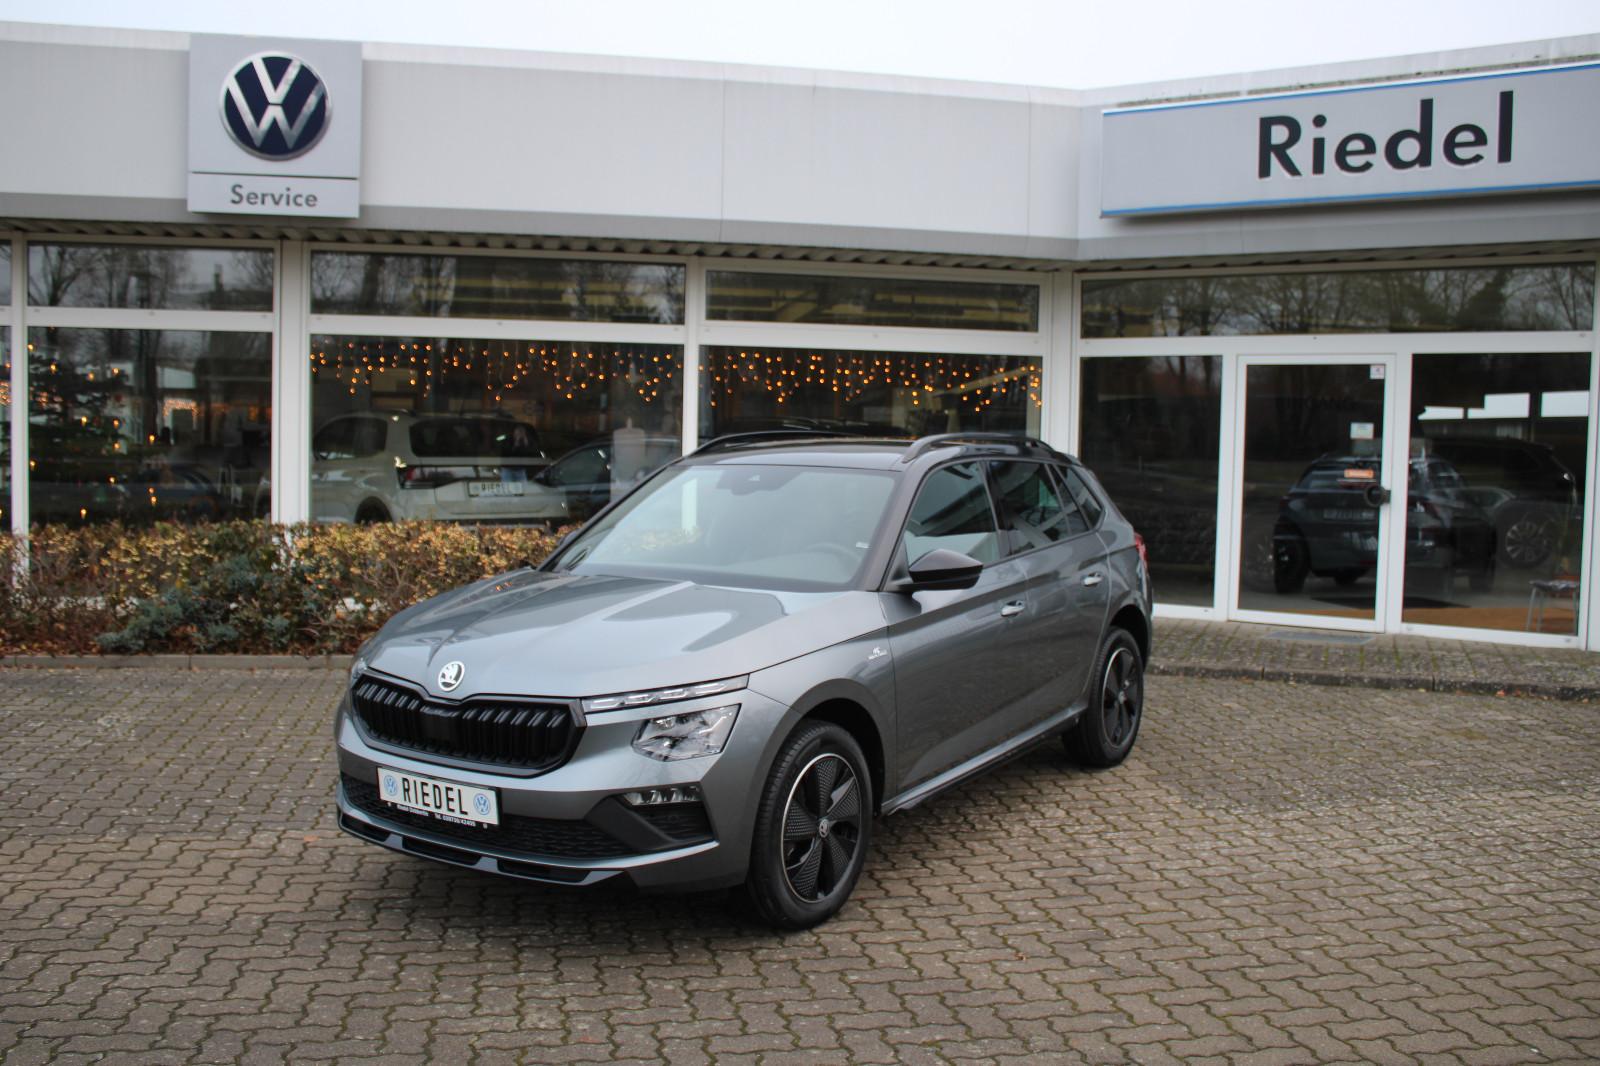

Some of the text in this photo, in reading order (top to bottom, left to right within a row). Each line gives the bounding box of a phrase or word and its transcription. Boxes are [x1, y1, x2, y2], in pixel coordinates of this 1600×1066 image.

[1258, 90, 1514, 179] Riedel
[230, 184, 318, 207] Service
[402, 777, 468, 815] RIEDEL
